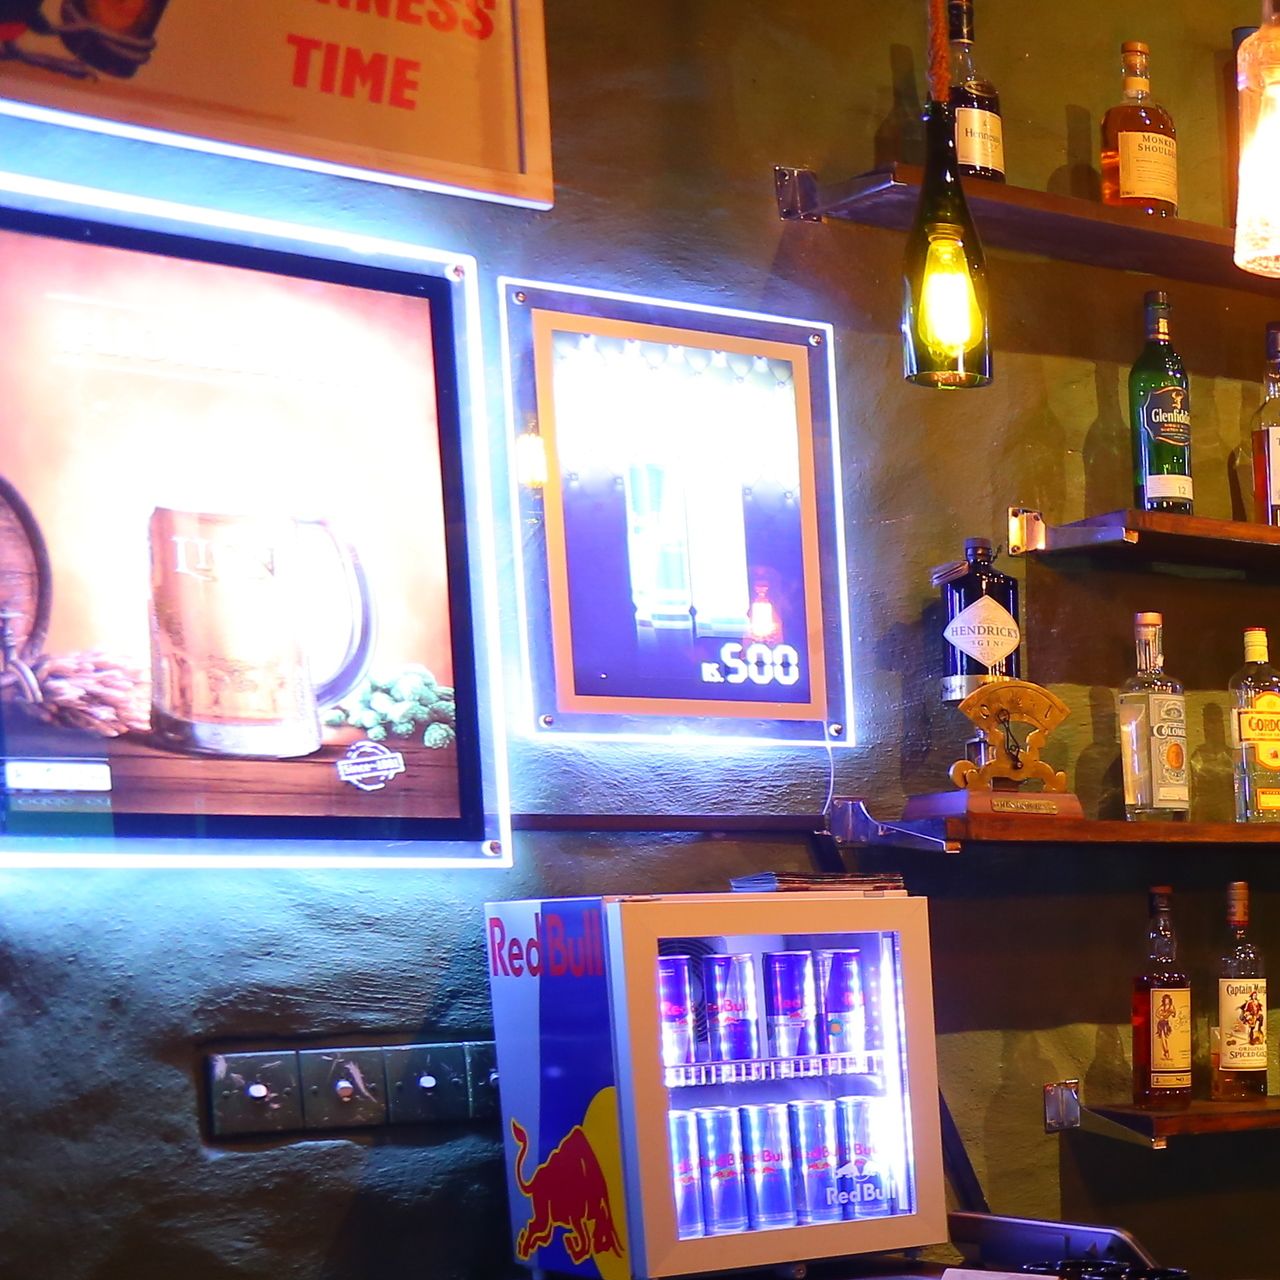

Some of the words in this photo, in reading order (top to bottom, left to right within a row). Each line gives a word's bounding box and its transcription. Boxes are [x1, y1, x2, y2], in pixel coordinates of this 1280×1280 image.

[286, 33, 421, 110] TIME
[1177, 485, 1187, 495] 12
[488, 912, 544, 977] Red
[545, 907, 603, 978] Bull
[827, 1184, 861, 1205] Red
[863, 1180, 896, 1201] Bull
